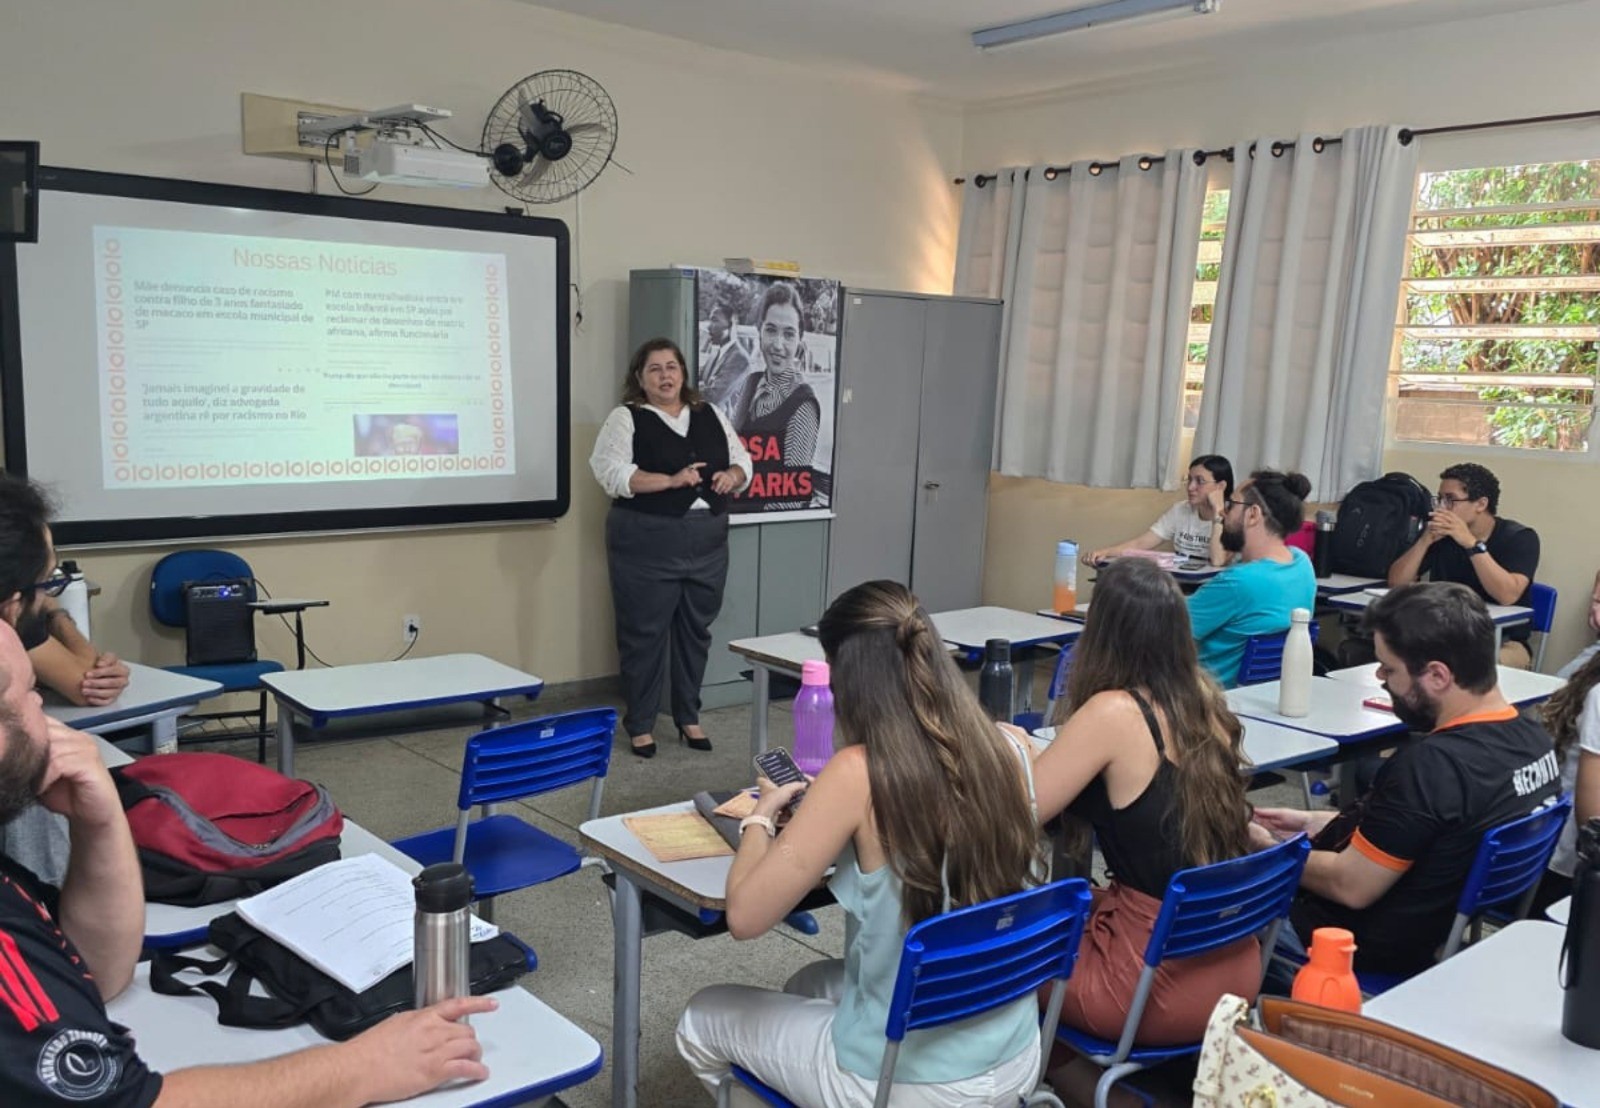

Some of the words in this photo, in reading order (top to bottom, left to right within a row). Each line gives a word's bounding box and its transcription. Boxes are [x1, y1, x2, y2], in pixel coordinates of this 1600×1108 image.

[233, 247, 312, 271] Nossas
[238, 285, 250, 296] de
[253, 286, 294, 298] racismo
[134, 295, 171, 305] contra
[173, 294, 197, 306] filho
[199, 295, 213, 306] de
[135, 307, 149, 317] de
[151, 308, 194, 319] macaco
[196, 310, 214, 319] em
[215, 309, 248, 320] escola
[250, 311, 300, 323] municipal
[301, 312, 314, 323] de
[136, 320, 149, 330] SP
[184, 382, 231, 396] imaginei
[241, 383, 292, 396] gravidade
[293, 384, 305, 393] de
[142, 397, 169, 407] tudo
[213, 397, 227, 407] diz
[230, 396, 280, 409] advogada
[143, 410, 197, 423] argentina
[212, 412, 230, 423] por
[233, 409, 273, 420] racismo
[275, 411, 288, 420] no
[290, 409, 307, 420] Rio
[739, 436, 781, 461] SA
[734, 471, 812, 498] ARKS
